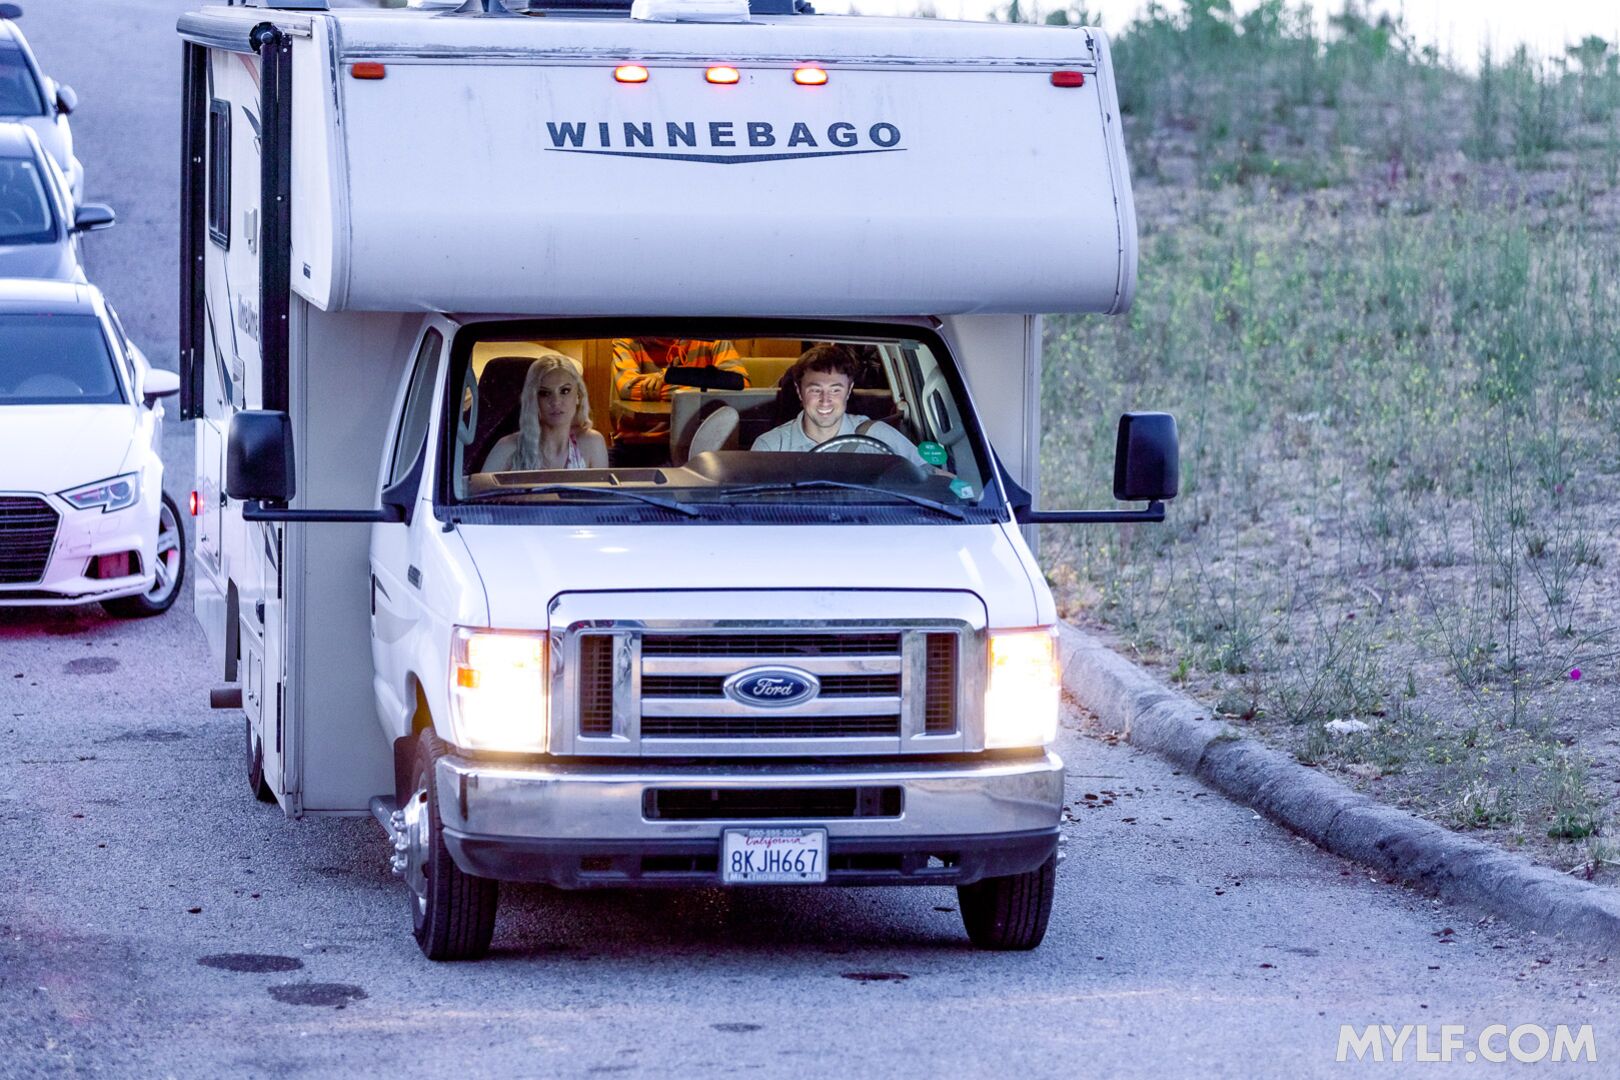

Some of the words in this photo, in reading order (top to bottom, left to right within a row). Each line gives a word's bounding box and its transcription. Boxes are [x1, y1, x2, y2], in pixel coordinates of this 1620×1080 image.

[546, 121, 901, 148] WINNEBAGO
[753, 677, 794, 696] Ford
[745, 836, 806, 848] California
[731, 849, 819, 873] 8KJH667
